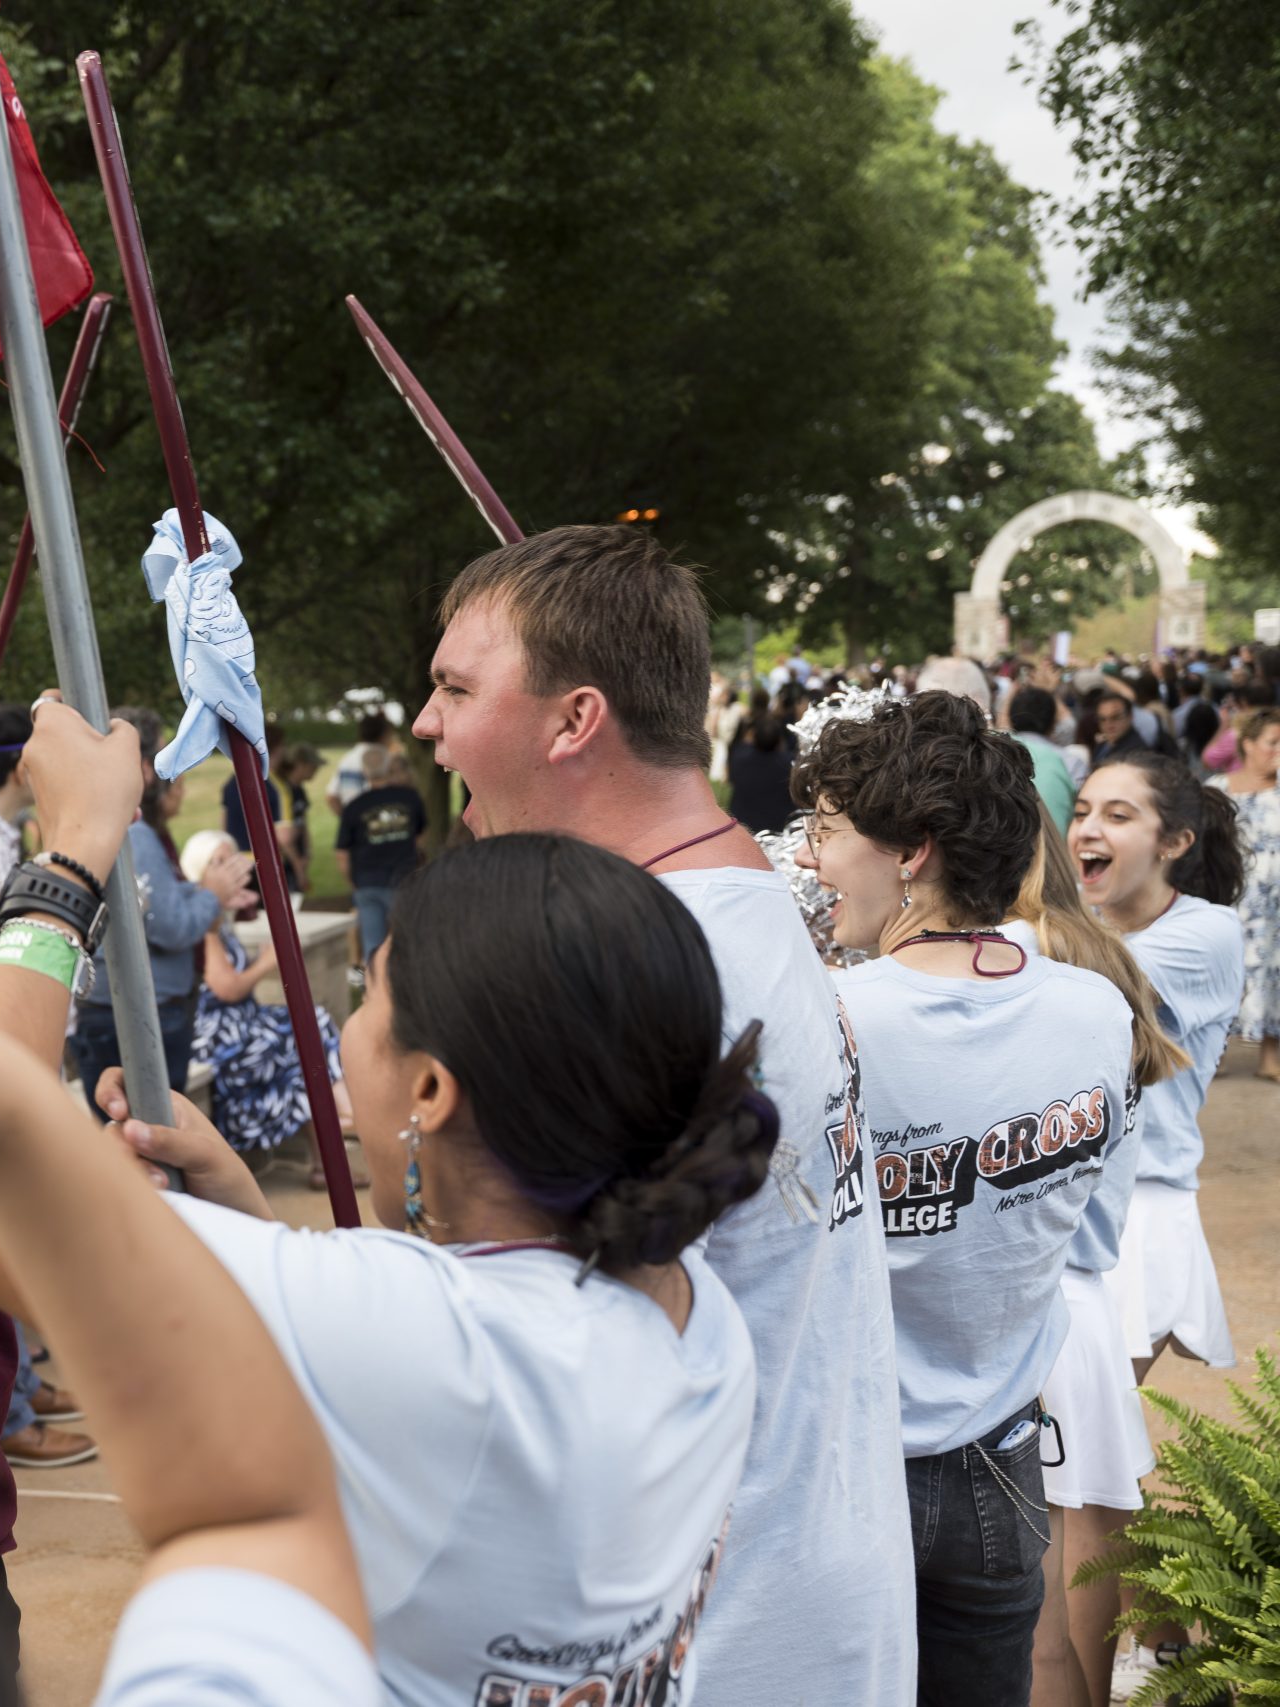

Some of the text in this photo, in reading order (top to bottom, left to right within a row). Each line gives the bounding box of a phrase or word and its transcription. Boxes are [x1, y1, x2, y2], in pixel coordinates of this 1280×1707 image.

[873, 1136, 969, 1202] OLY
[975, 1085, 1106, 1178] CROSS
[900, 1122, 943, 1147] from
[883, 1201, 954, 1232] LEGE
[994, 1191, 1035, 1214] Notre
